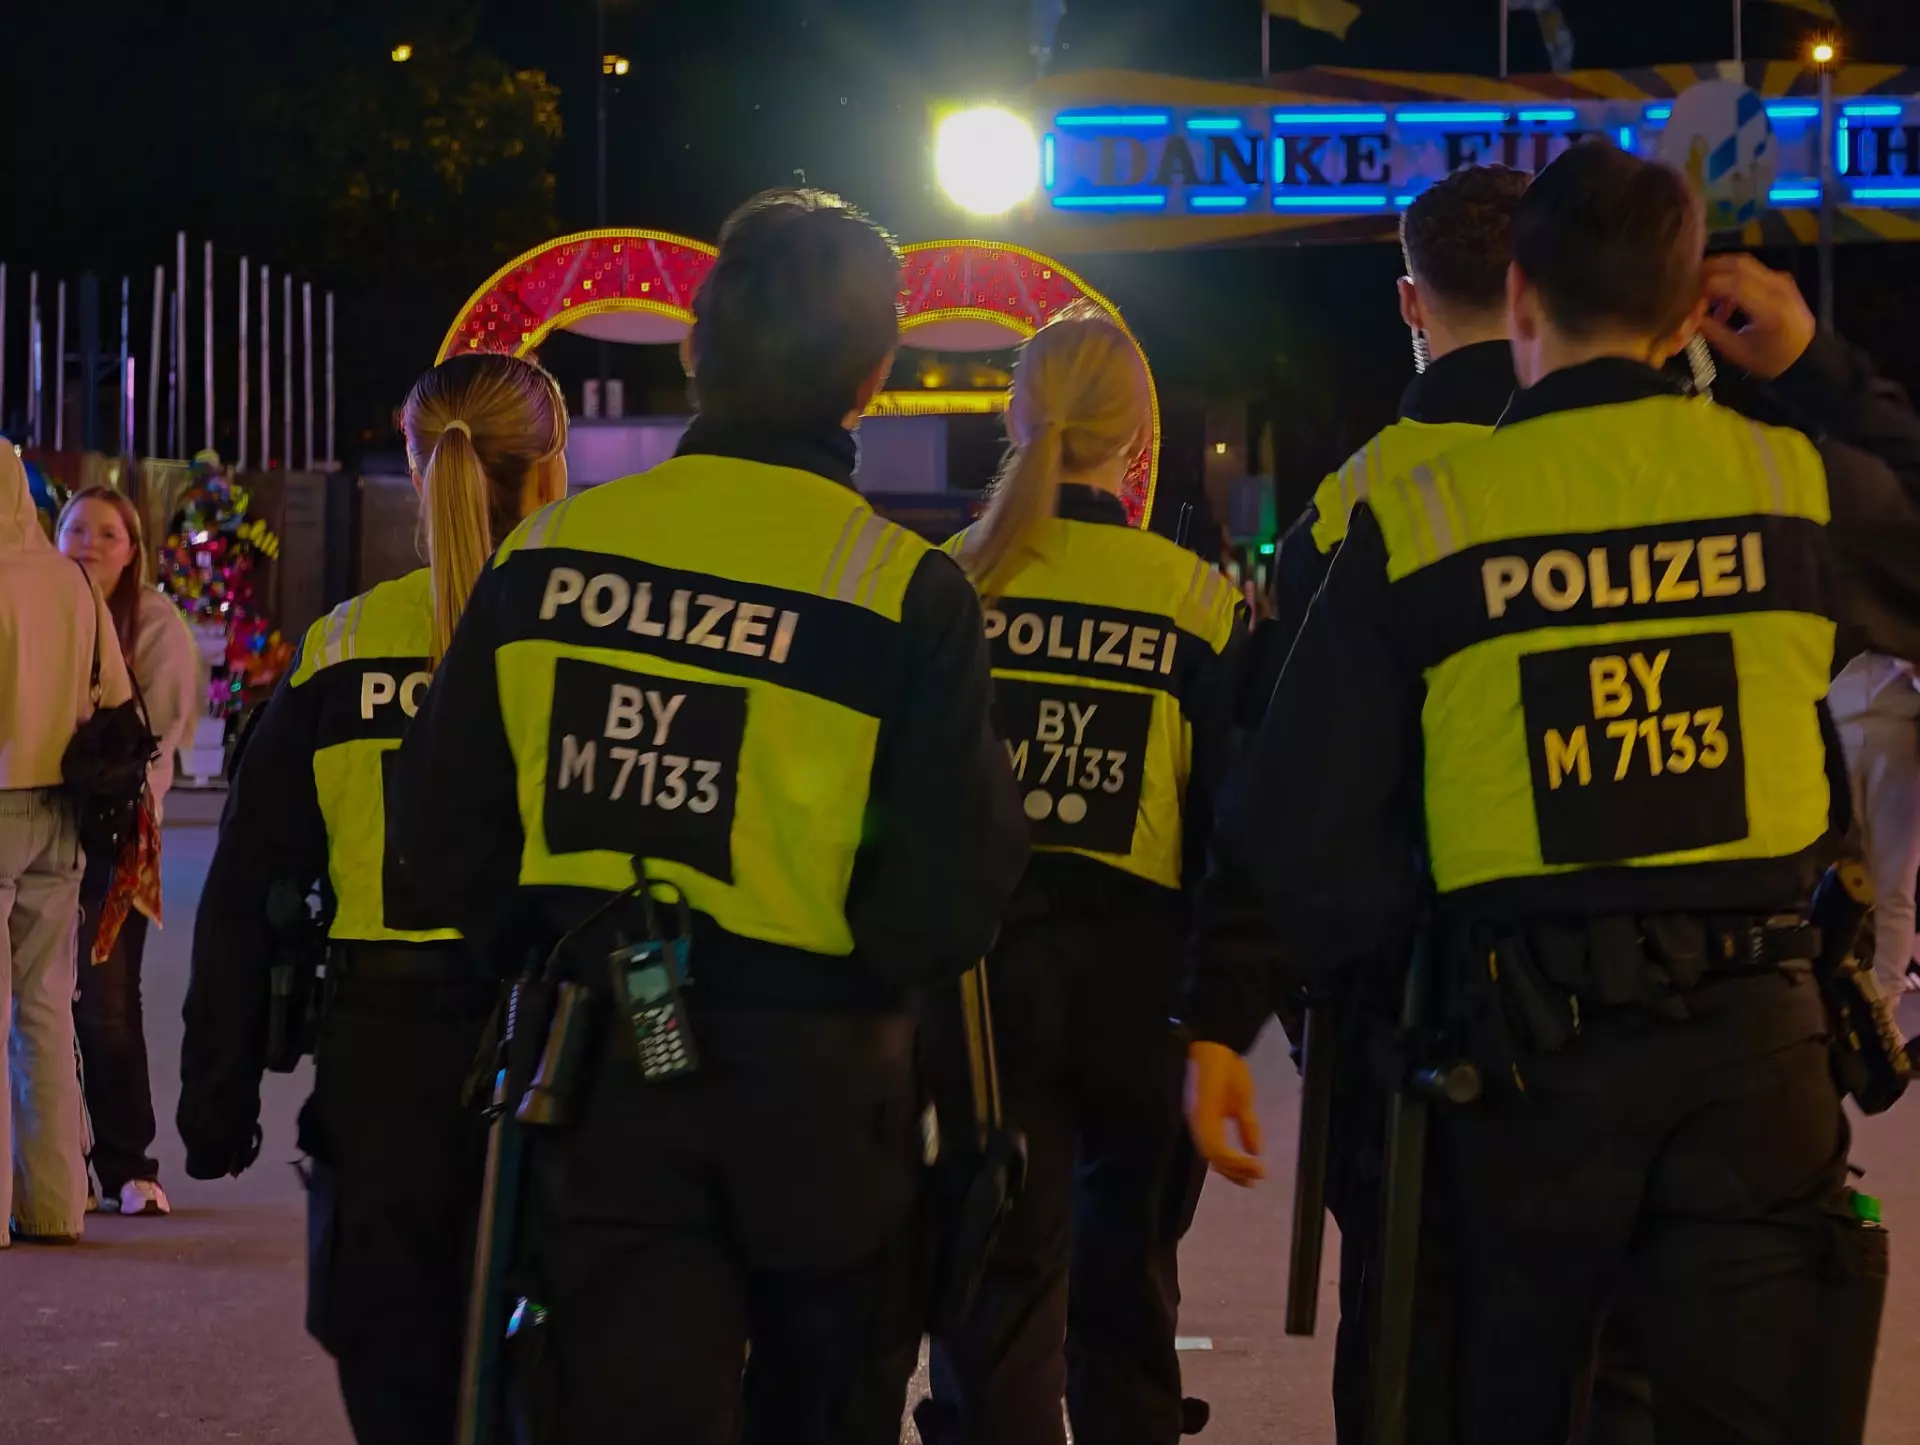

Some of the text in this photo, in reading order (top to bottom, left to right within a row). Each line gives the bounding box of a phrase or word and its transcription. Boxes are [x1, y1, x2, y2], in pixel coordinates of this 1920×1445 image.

[1094, 136, 1391, 186] DANKE
[1481, 531, 1766, 619] POLIZEI
[539, 568, 799, 663] POLIZEI
[983, 608, 1178, 675] POLIZEI
[604, 683, 686, 746] BY
[1589, 649, 1671, 720] BY
[1036, 699, 1098, 745] BY
[1543, 705, 1729, 791] M 7133
[558, 734, 721, 813] M 7133
[1039, 743, 1127, 793] 7133
